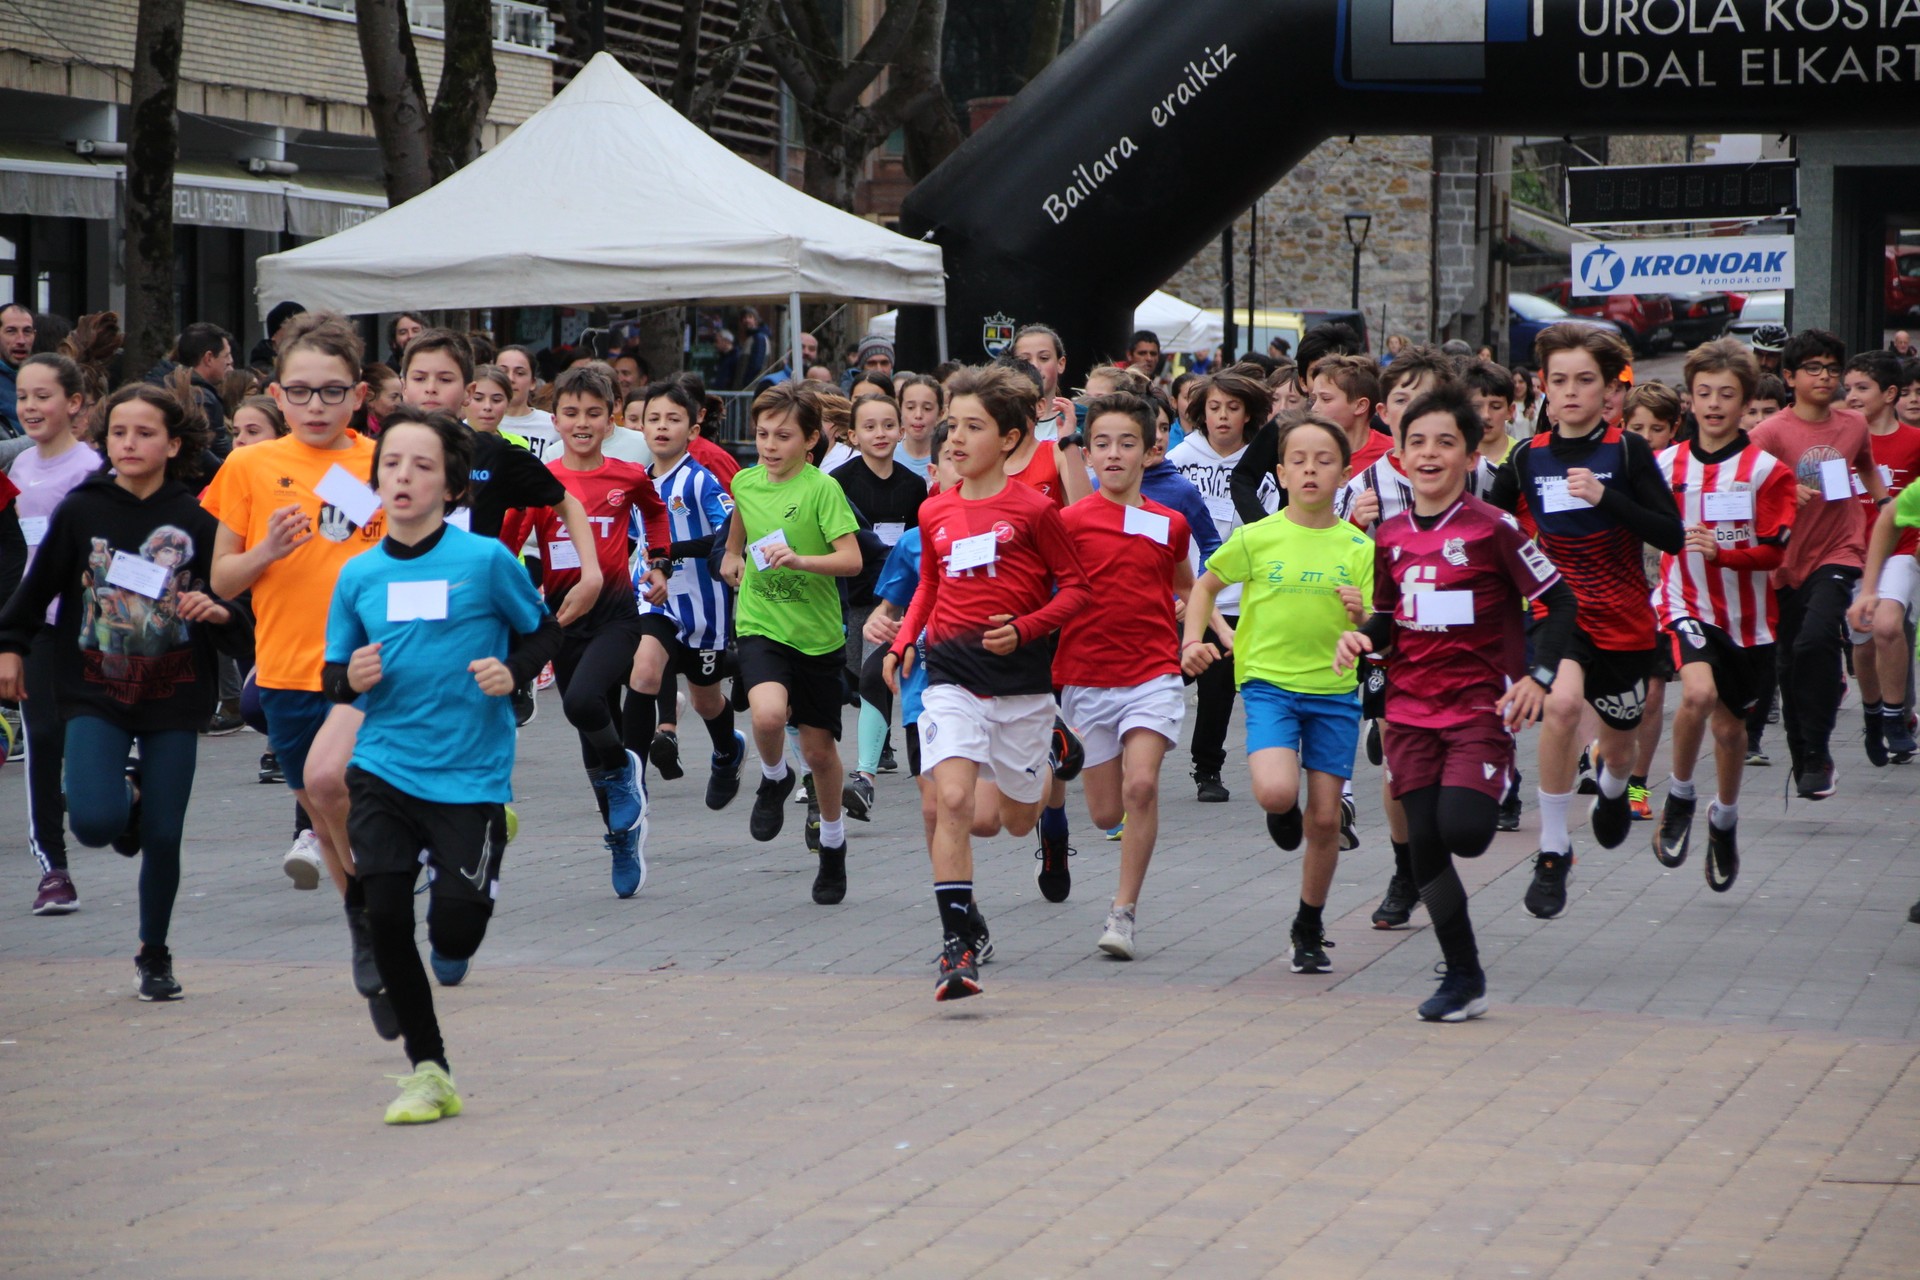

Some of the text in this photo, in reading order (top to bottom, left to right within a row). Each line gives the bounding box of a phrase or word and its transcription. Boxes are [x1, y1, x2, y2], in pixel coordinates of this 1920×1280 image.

[1578, 0, 1746, 36] UROLA
[1578, 50, 1717, 89] UDAL
[1042, 43, 1237, 224] Bailara eraikiz
[1630, 251, 1787, 277] KRONOAK
[1701, 275, 1781, 286] kronoak.com
